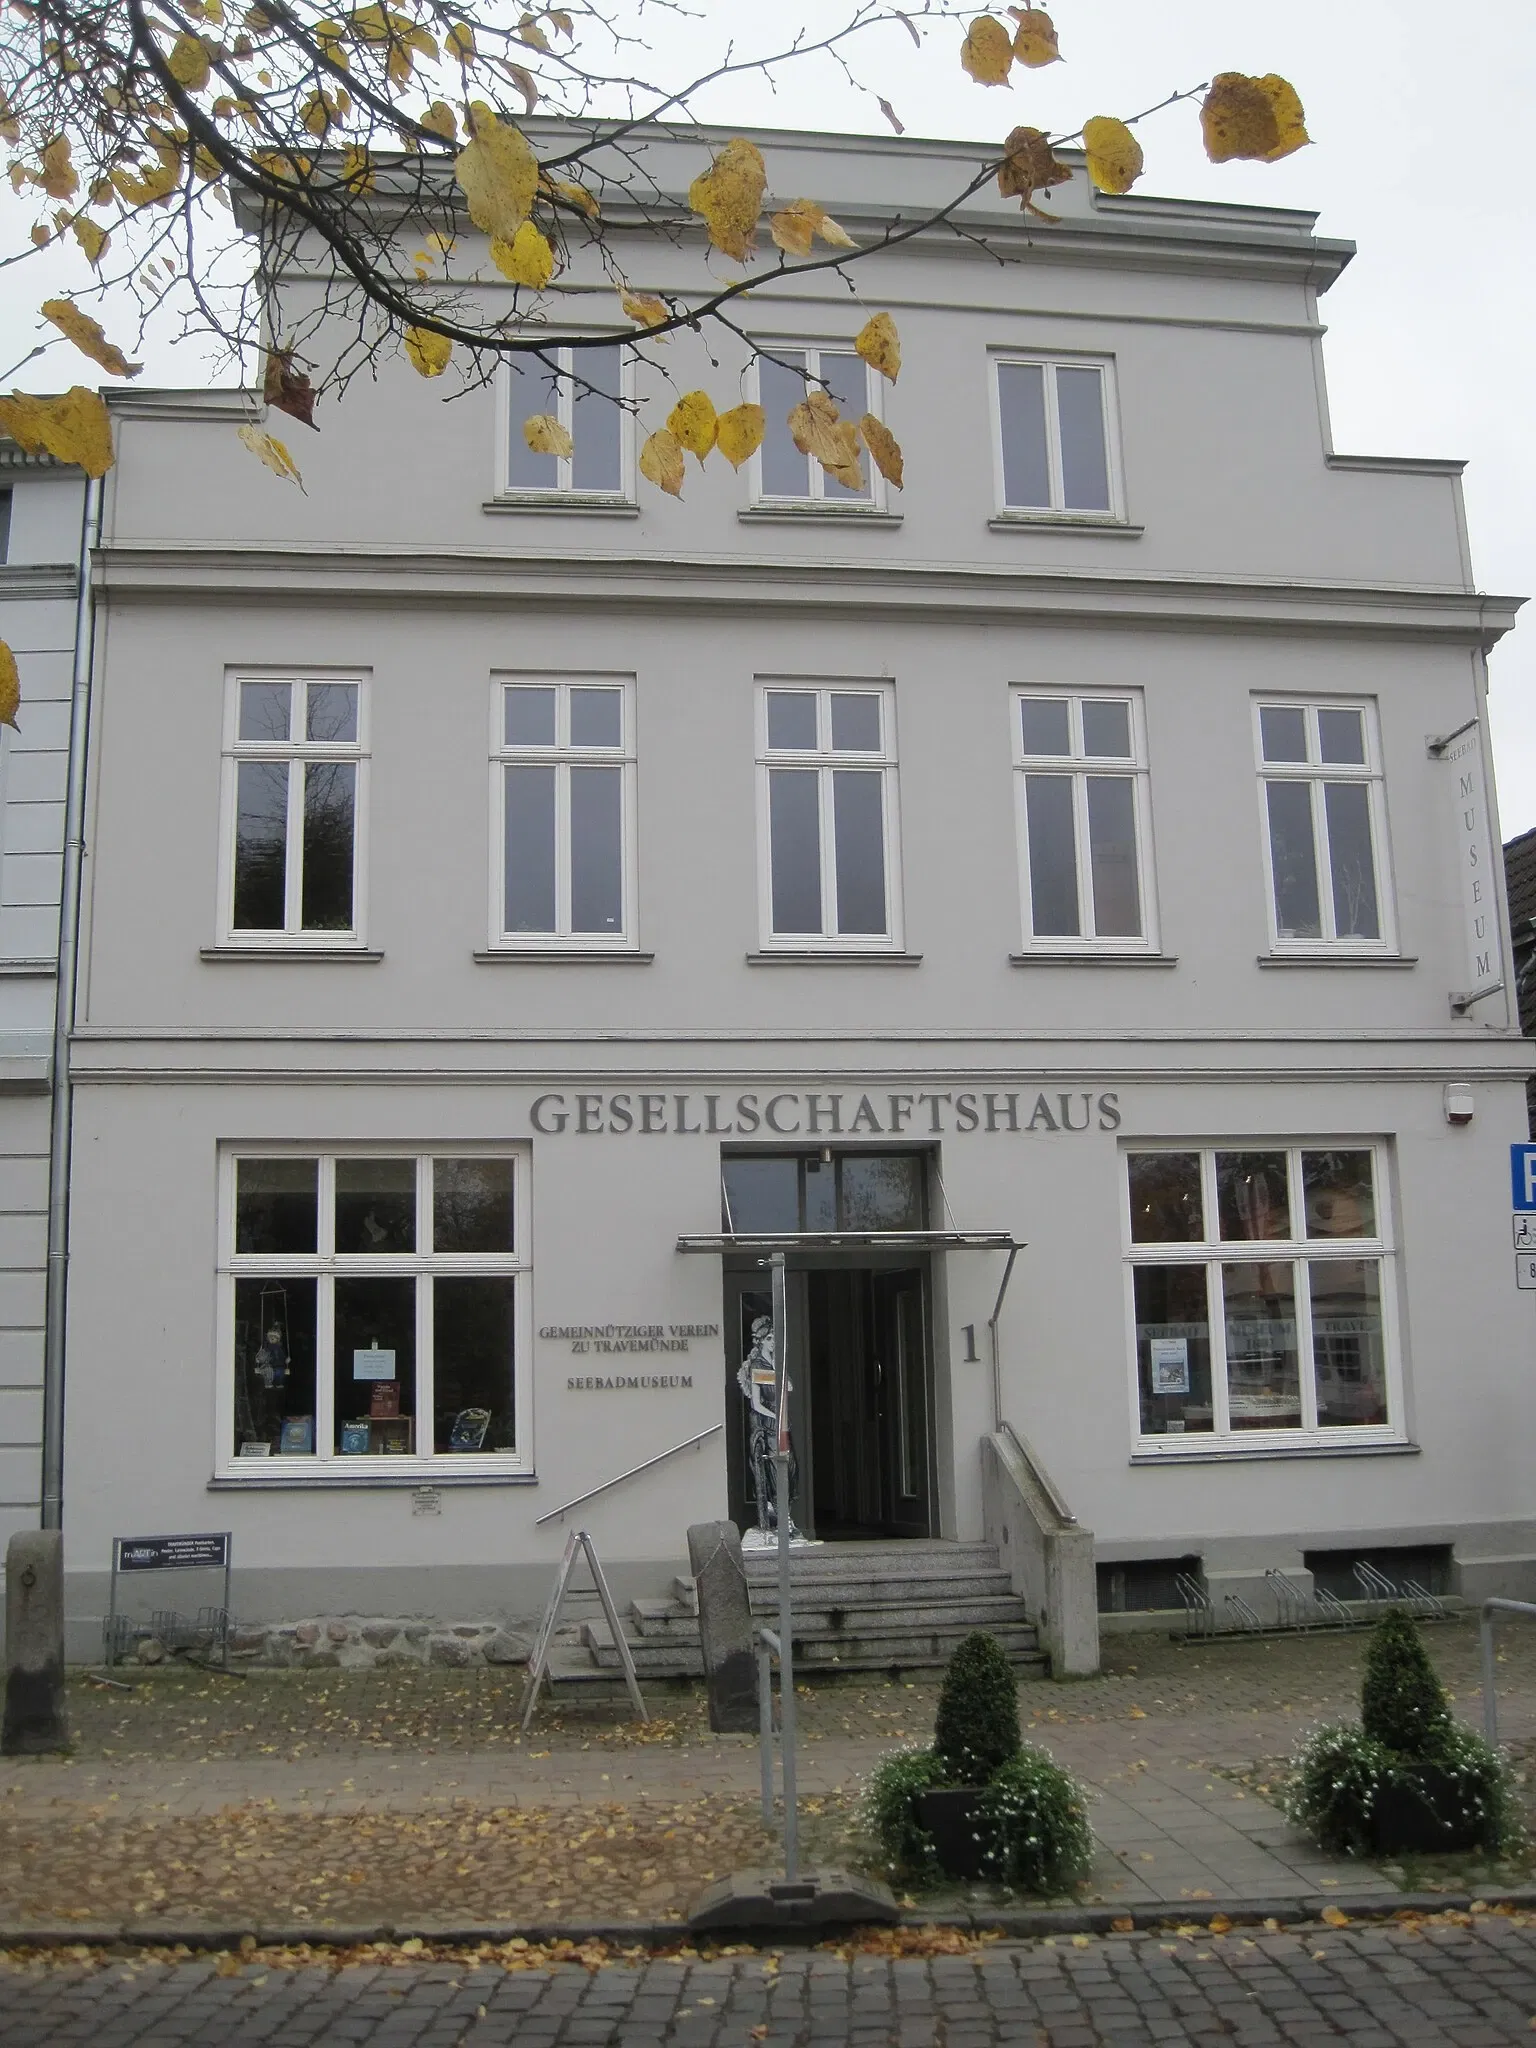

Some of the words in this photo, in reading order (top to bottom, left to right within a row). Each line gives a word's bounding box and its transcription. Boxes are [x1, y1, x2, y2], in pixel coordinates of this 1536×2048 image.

[1449, 737, 1476, 763] SEEBAD
[1459, 770, 1491, 978] MUSEUM
[529, 1091, 1122, 1136] GESELLSCHAFTSHAUS
[539, 1324, 665, 1339] GEMEINNÜTZIGER
[669, 1324, 719, 1338] VEREIN
[960, 1323, 982, 1364] 1
[571, 1340, 591, 1354] ZU
[595, 1337, 689, 1353] TRAVEMÜNDE
[567, 1376, 693, 1390] SEEBADMUSEUM
